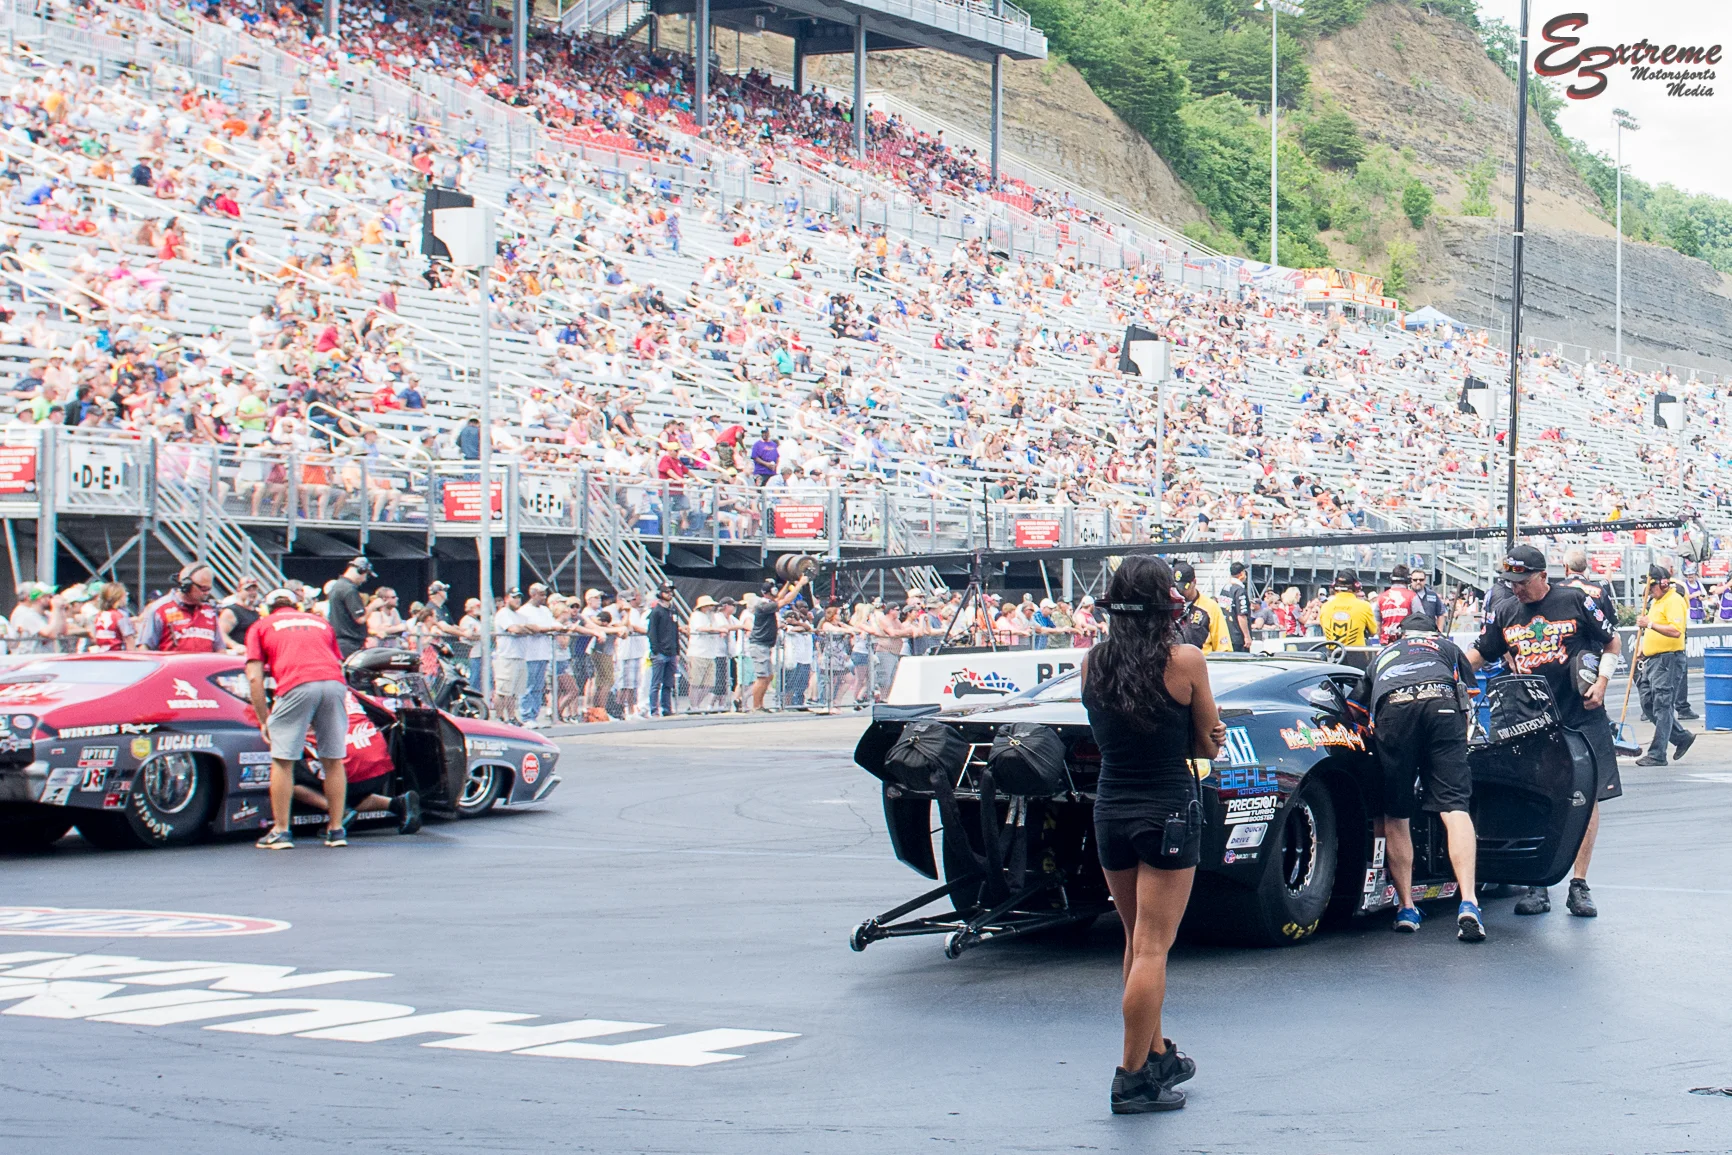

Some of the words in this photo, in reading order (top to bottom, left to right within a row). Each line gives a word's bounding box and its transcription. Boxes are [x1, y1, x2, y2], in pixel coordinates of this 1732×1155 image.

[1504, 615, 1577, 645] Western
[1518, 636, 1562, 657] Beef
[1515, 645, 1568, 674] Racing
[58, 724, 119, 739] WINTERS
[120, 722, 159, 735] Racing
[1280, 719, 1327, 751] Western
[156, 735, 195, 751] LUCAS
[195, 734, 214, 748] OIL
[81, 748, 117, 760] OPTIMA
[1220, 766, 1278, 790] BIEHLE
[1237, 785, 1279, 796] MOTORSPORTS
[1228, 795, 1277, 813] PRECISION
[1250, 808, 1275, 816] TURBO
[293, 814, 322, 825] TESTED
[1248, 814, 1275, 822] BOOSTED
[1244, 825, 1263, 834] QUICK
[0, 977, 802, 1067] THUN
